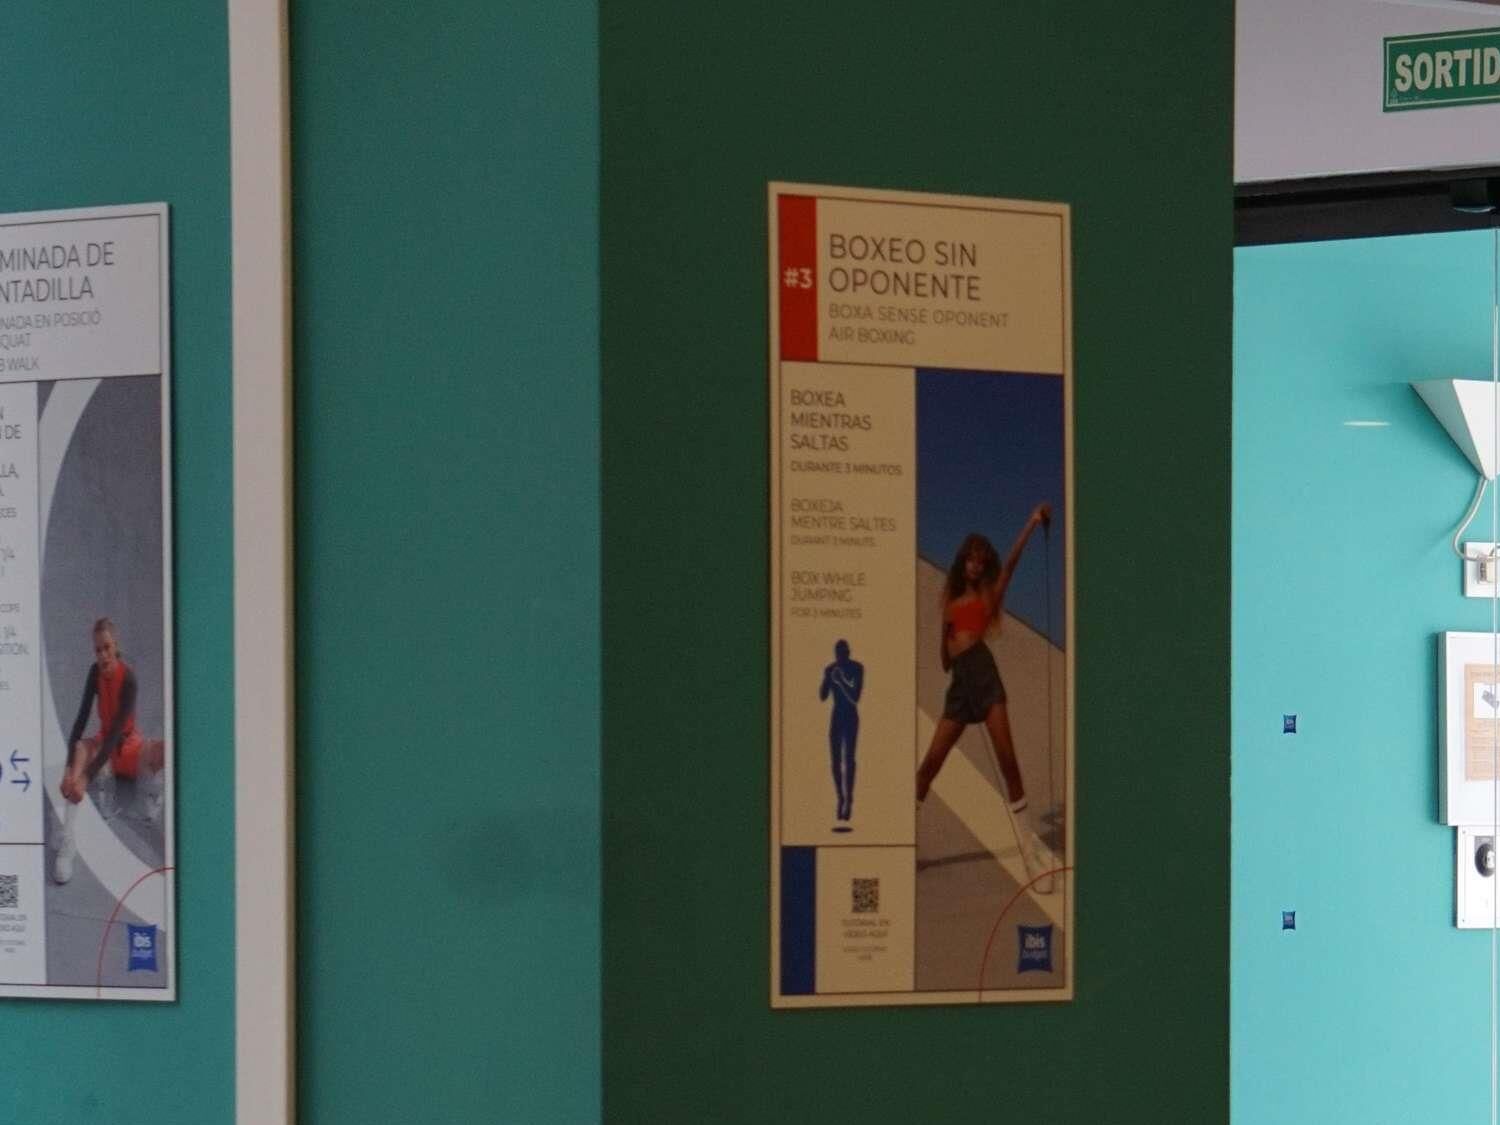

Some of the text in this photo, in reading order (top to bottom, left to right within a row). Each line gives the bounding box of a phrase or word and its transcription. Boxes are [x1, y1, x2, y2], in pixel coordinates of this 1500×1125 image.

[87, 241, 115, 267] DE
[829, 233, 977, 268] BOXEO SIN
[784, 267, 813, 289] #3
[829, 267, 982, 301] OPONENTE
[829, 303, 1009, 328] BOXA SENSE OPONENT
[829, 326, 916, 345] AIR BOXING
[790, 388, 847, 407] BOXEA
[790, 412, 872, 431] MIENTRAS
[790, 433, 849, 452] SALTAS
